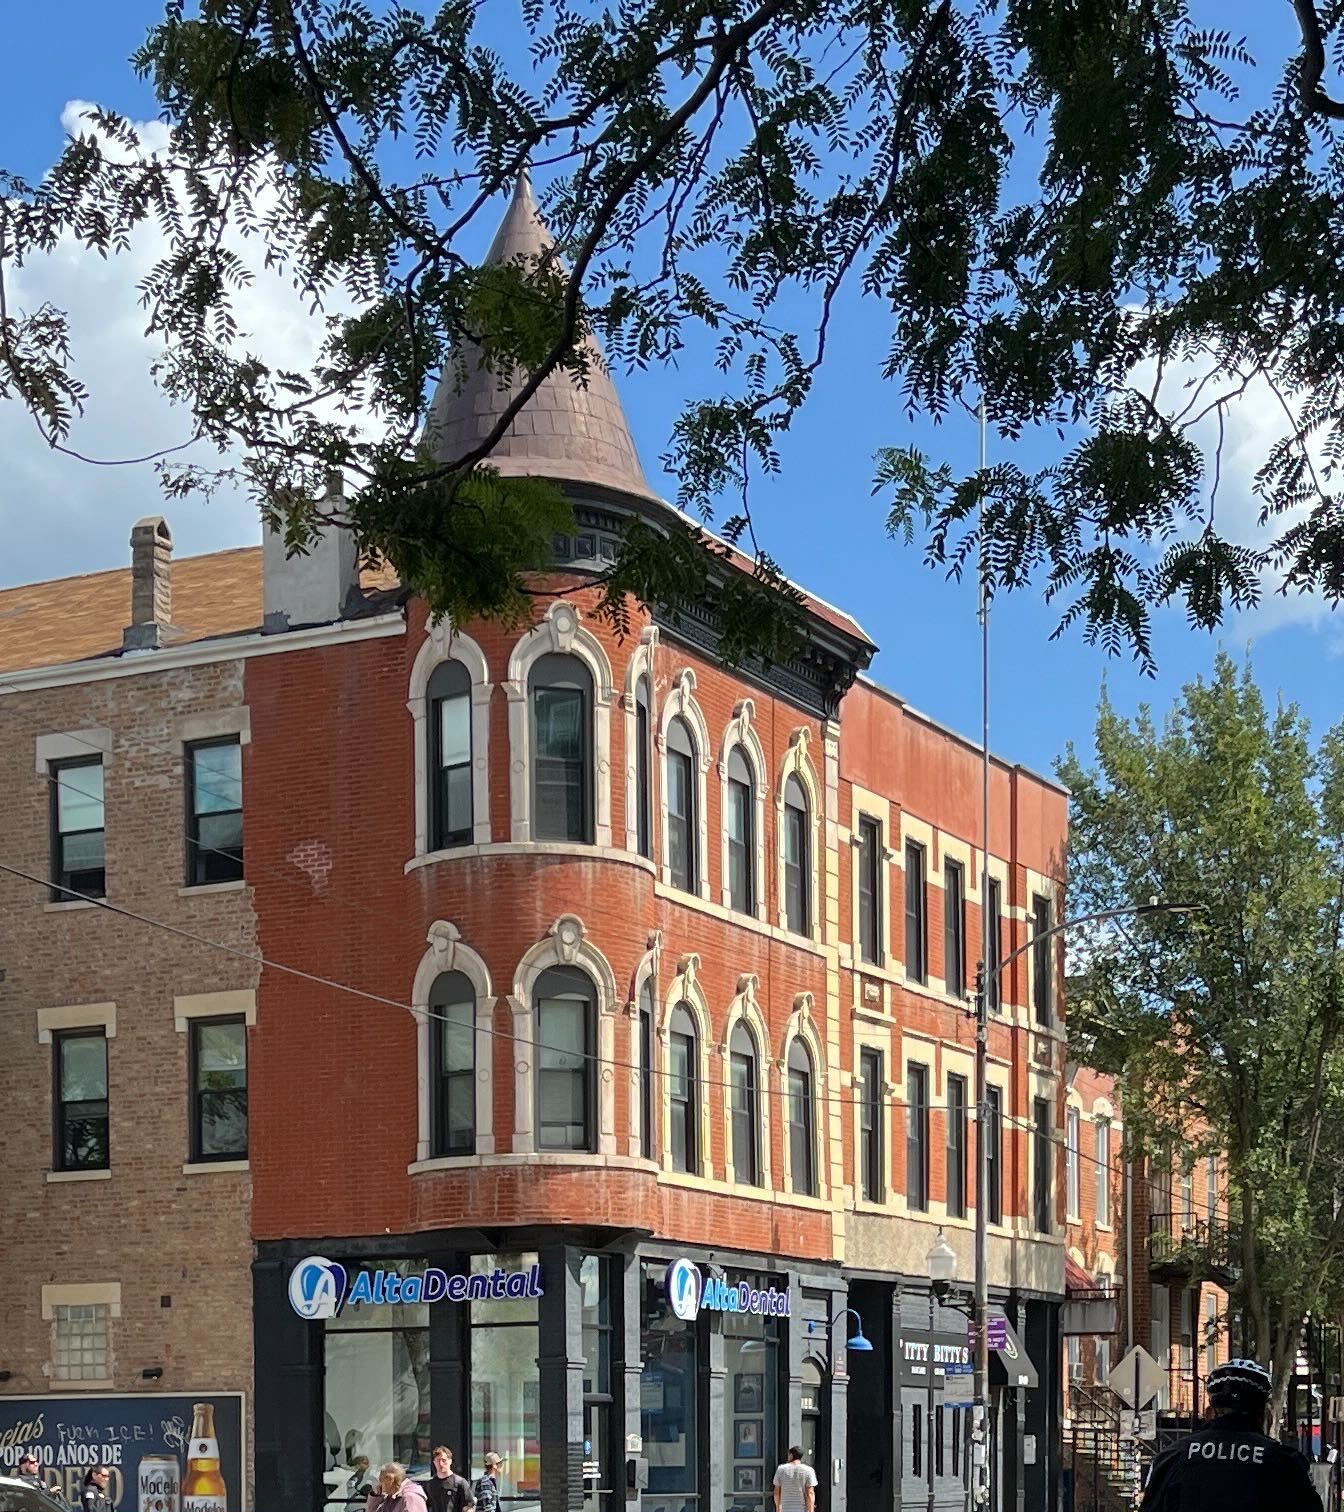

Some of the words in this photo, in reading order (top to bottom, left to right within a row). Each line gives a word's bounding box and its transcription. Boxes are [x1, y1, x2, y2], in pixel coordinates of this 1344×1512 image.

[347, 1263, 545, 1306] AltaDental
[701, 1276, 791, 1317] AltaDental
[904, 1342, 930, 1361] ITTY
[57, 1440, 99, 1466] AÑOS
[101, 1444, 123, 1466] DE
[1187, 1441, 1265, 1464] POLICE
[140, 1475, 179, 1496] Modelo
